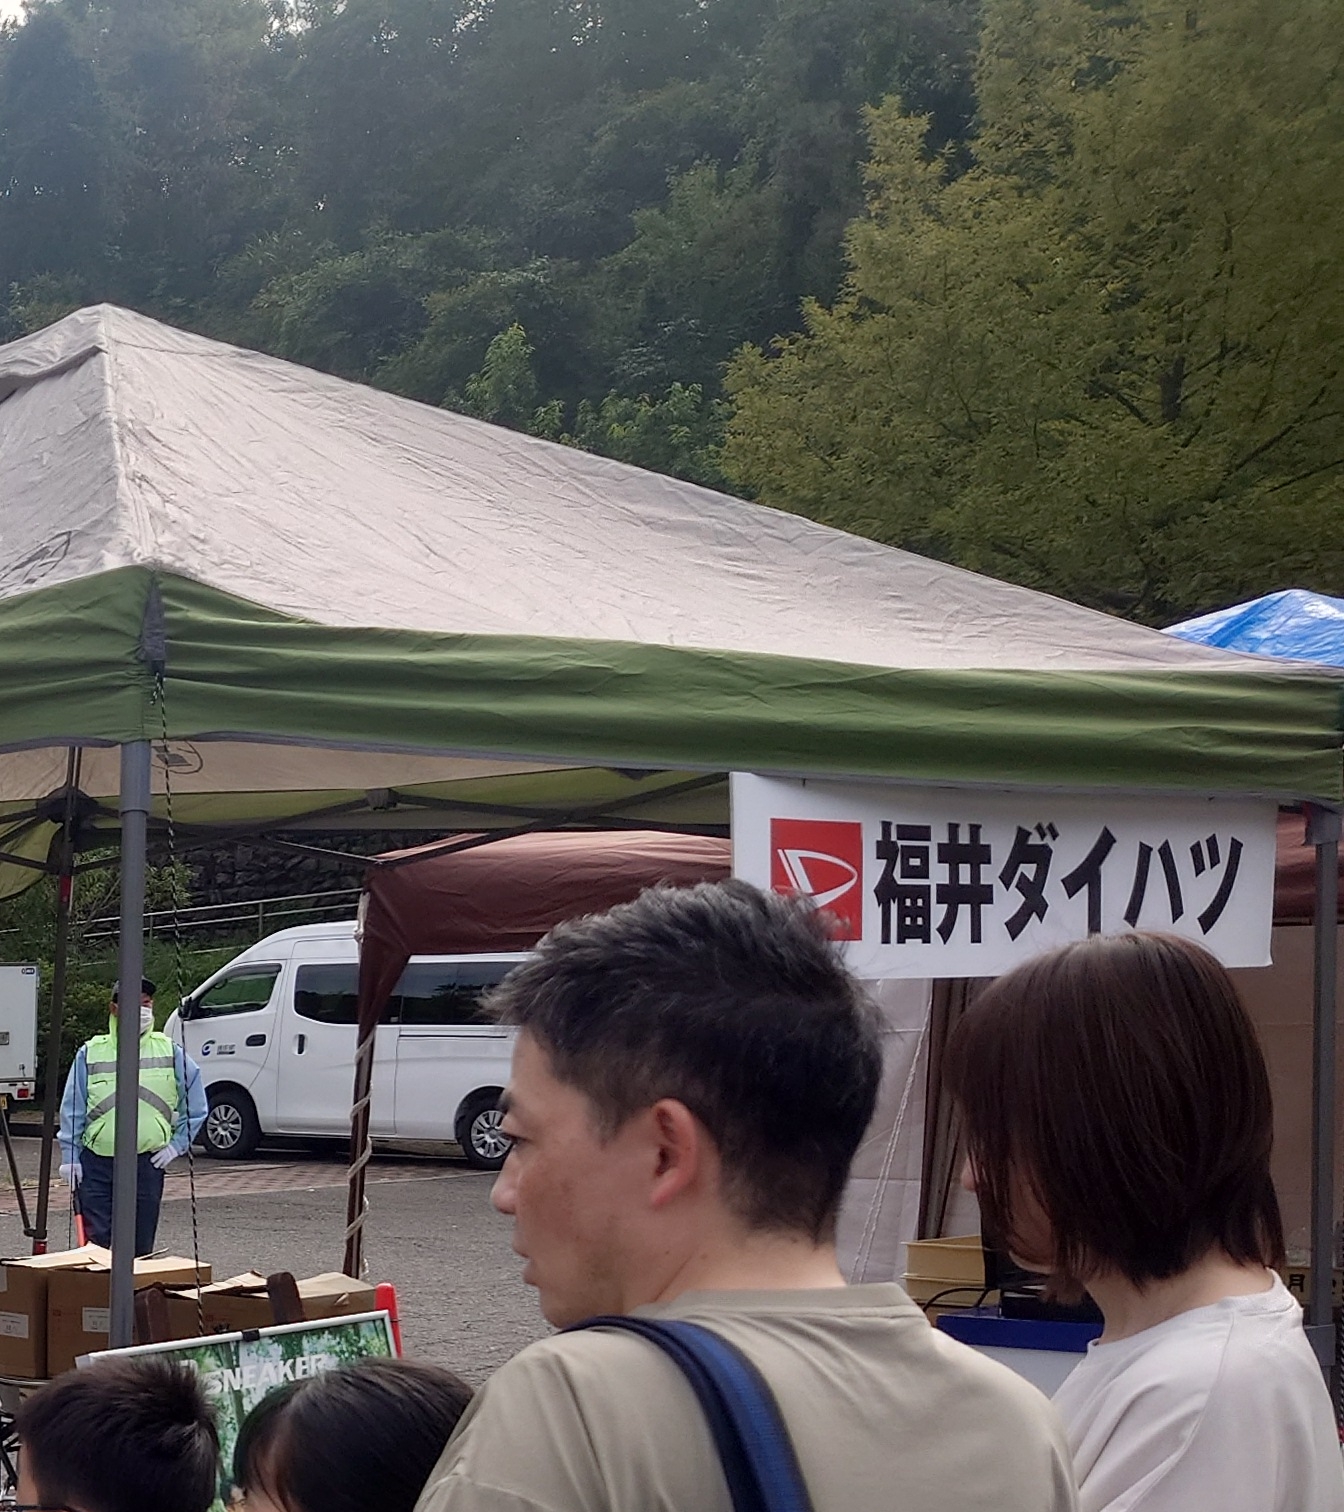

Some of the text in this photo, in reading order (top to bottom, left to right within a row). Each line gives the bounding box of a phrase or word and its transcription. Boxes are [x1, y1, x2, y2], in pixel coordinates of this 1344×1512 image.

[873, 820, 1243, 945] 福井ダイハツ
